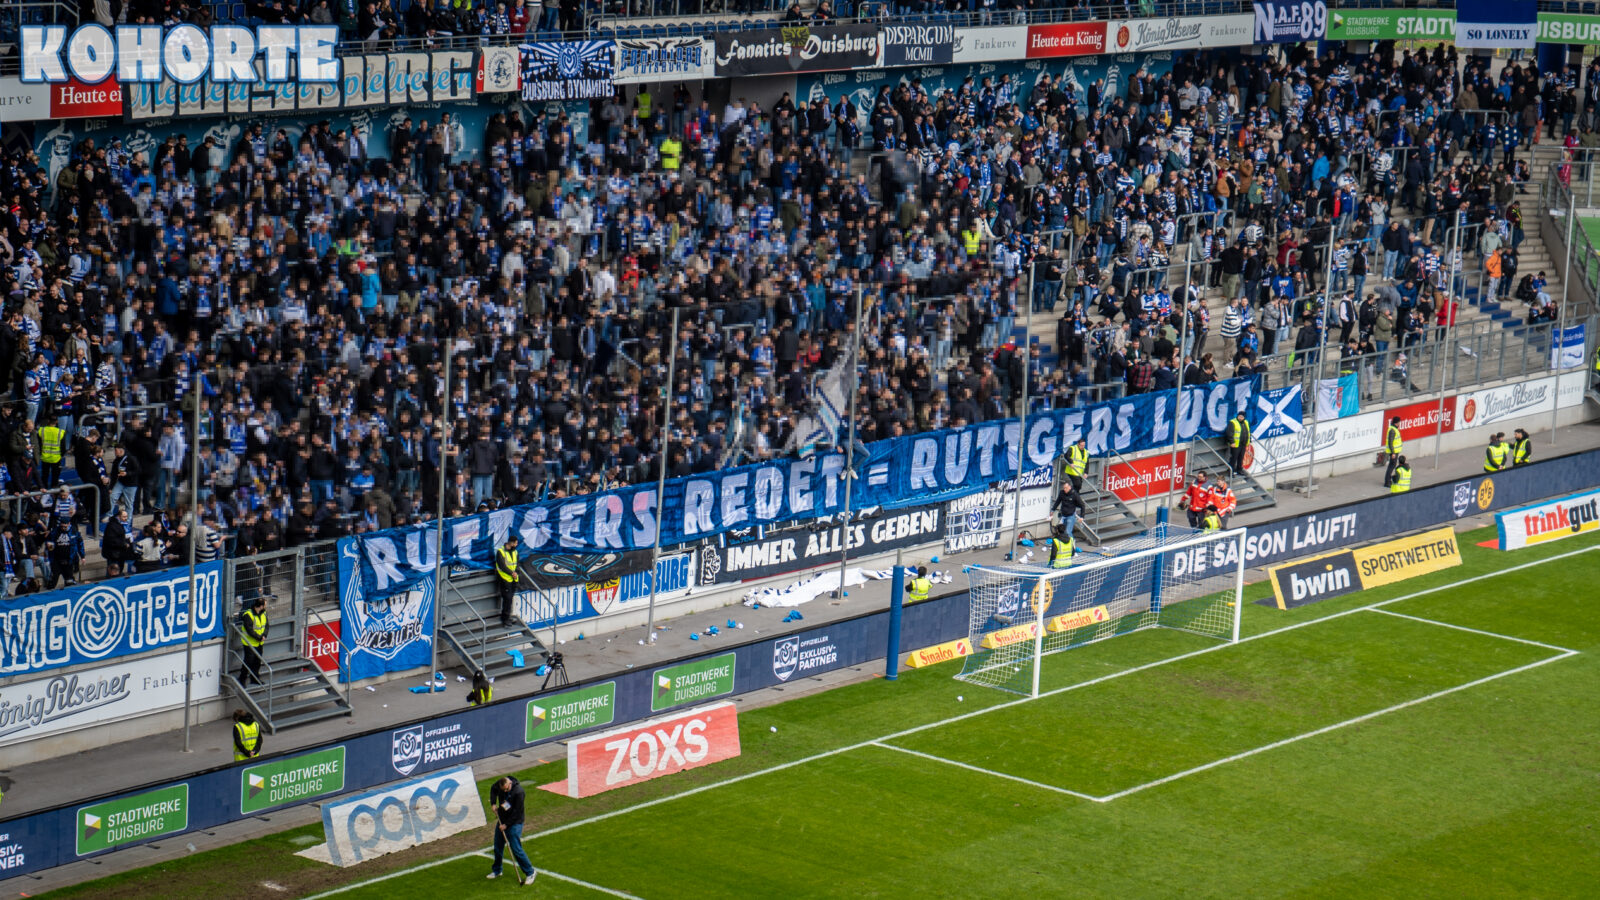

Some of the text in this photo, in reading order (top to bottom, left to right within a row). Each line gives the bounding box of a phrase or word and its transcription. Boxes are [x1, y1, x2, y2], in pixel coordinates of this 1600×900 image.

[1210, 26, 1247, 36] Fankurve
[1346, 17, 1389, 27] STADTWERKE
[1346, 26, 1379, 35] DUISBURG
[885, 25, 953, 45] DISPARGUM
[974, 38, 1017, 50] Fankurve
[1032, 30, 1103, 49] Heute ein König
[1467, 29, 1530, 40] SO LONELY
[716, 37, 792, 66] Fanatics
[800, 34, 877, 60] Duisburg
[905, 46, 933, 61] MCMII
[60, 86, 106, 105] Heute
[522, 79, 566, 101] DUISBURG
[1268, 427, 1284, 436] PTFC
[1413, 416, 1425, 427] ein
[1342, 426, 1377, 441] Fankurve
[1106, 474, 1135, 491] Heute
[1137, 472, 1153, 485] ein
[684, 454, 845, 535] REDET
[950, 491, 1003, 513] RUHRPOTT
[1524, 498, 1598, 536] trinkgut
[727, 509, 938, 573] IMMER ALLES GEBEN!
[949, 531, 997, 551] KANAKEN
[1173, 513, 1357, 578] DIE SASON LÄUFT!
[1361, 538, 1456, 577] SPORTWETTEN
[619, 555, 689, 603] DUISBURG
[1291, 564, 1350, 600] bwin
[124, 569, 219, 649] TREU
[1060, 614, 1091, 630] Sinalco
[994, 631, 1027, 646] Sinalco
[799, 652, 837, 671] PARTNER
[800, 644, 837, 661] EXKLUSIV-
[919, 647, 954, 666] Sinalco
[675, 665, 730, 689] STADTWERKE
[0, 673, 131, 726] önig Pilsener
[674, 681, 717, 702] DUISBURG
[551, 694, 609, 718] STADTWERKE
[425, 723, 461, 738] OFFIZIELLER
[550, 711, 596, 733] DUISBURG
[424, 734, 471, 752] EXKLUSIV-
[424, 742, 473, 764] PARTNER
[605, 719, 709, 786] ZOXS
[270, 760, 338, 788] STADTWERKE
[270, 778, 323, 802] DUISBURG
[108, 799, 181, 828] STADTWERKE
[347, 778, 469, 861] pape
[107, 817, 164, 843] DUISBURG
